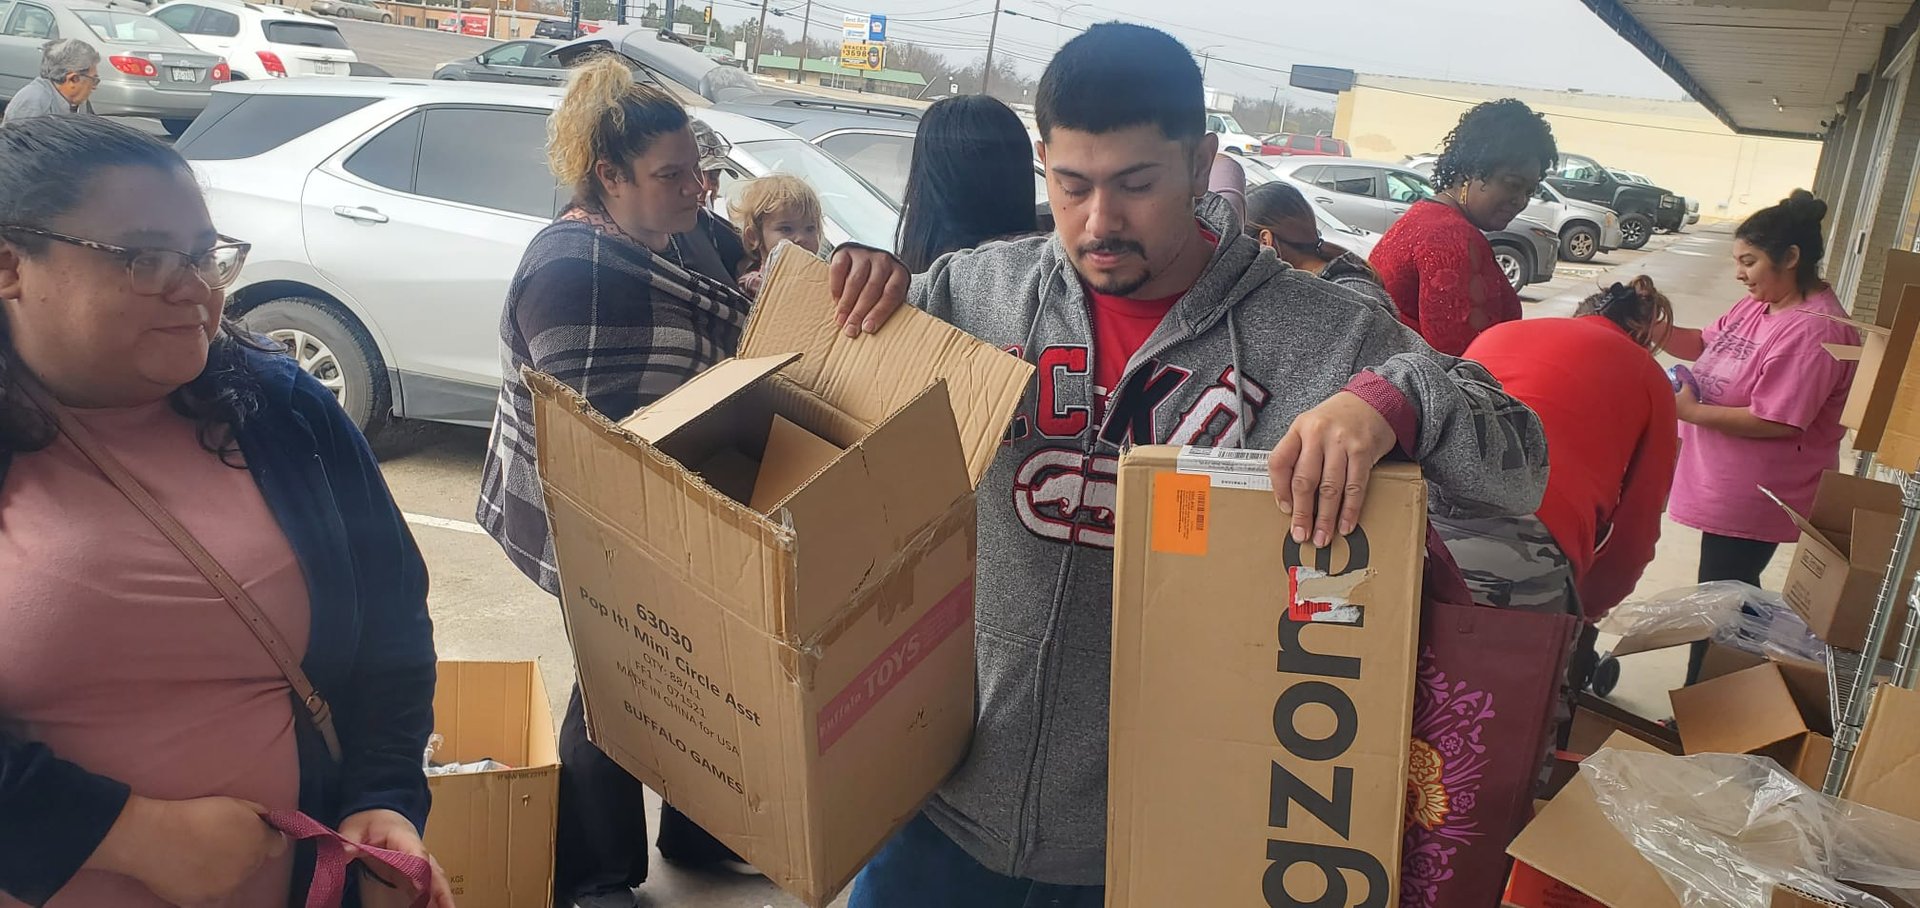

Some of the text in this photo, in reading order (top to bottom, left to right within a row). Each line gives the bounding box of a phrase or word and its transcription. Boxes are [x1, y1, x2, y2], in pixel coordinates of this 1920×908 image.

[580, 586, 761, 727] Pop It! Mini Circle Asst
[636, 603, 693, 653] 63030
[643, 653, 667, 677] QTY:
[864, 633, 920, 697] TOYS
[616, 661, 740, 757] MADE IN CHINA for USA
[624, 700, 744, 795] BUFFALO GAMES
